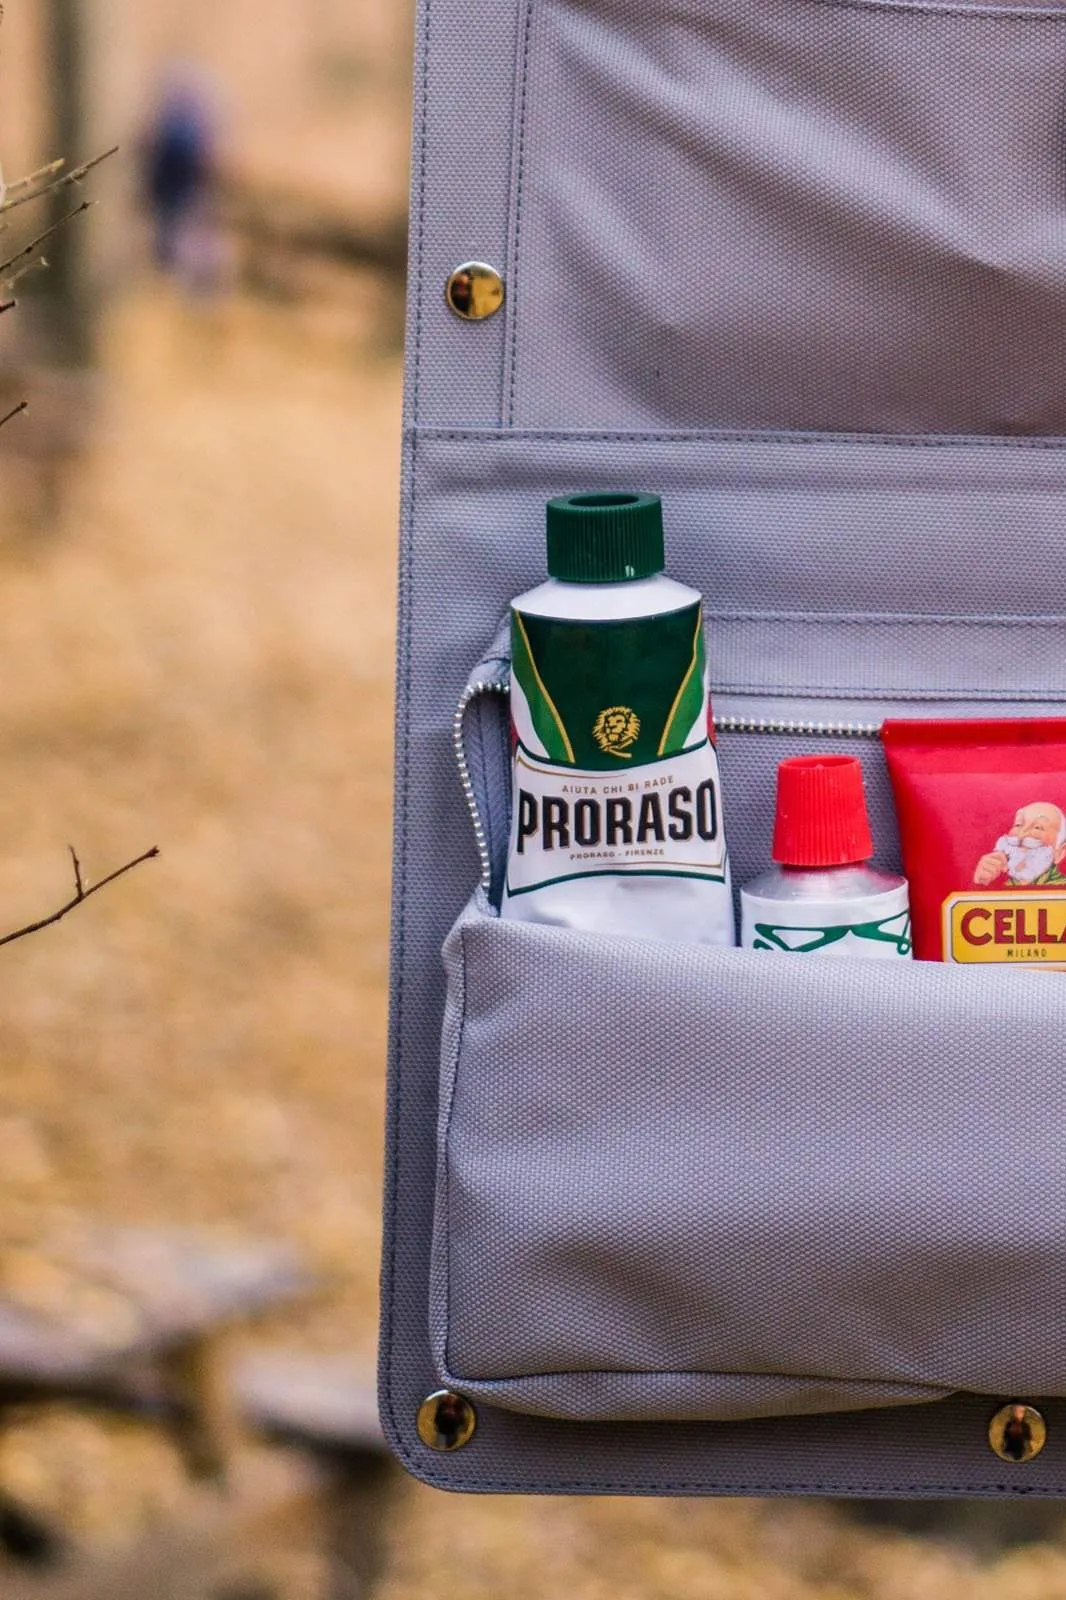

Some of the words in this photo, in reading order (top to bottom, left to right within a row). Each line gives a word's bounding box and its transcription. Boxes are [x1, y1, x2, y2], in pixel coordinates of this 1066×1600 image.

[562, 784, 597, 794] AIUTA
[603, 785, 623, 794] CHI
[644, 775, 674, 789] RADE
[516, 777, 718, 855] PRORASO
[625, 849, 664, 857] FIRENZE
[1006, 948, 1047, 958] MILANO
